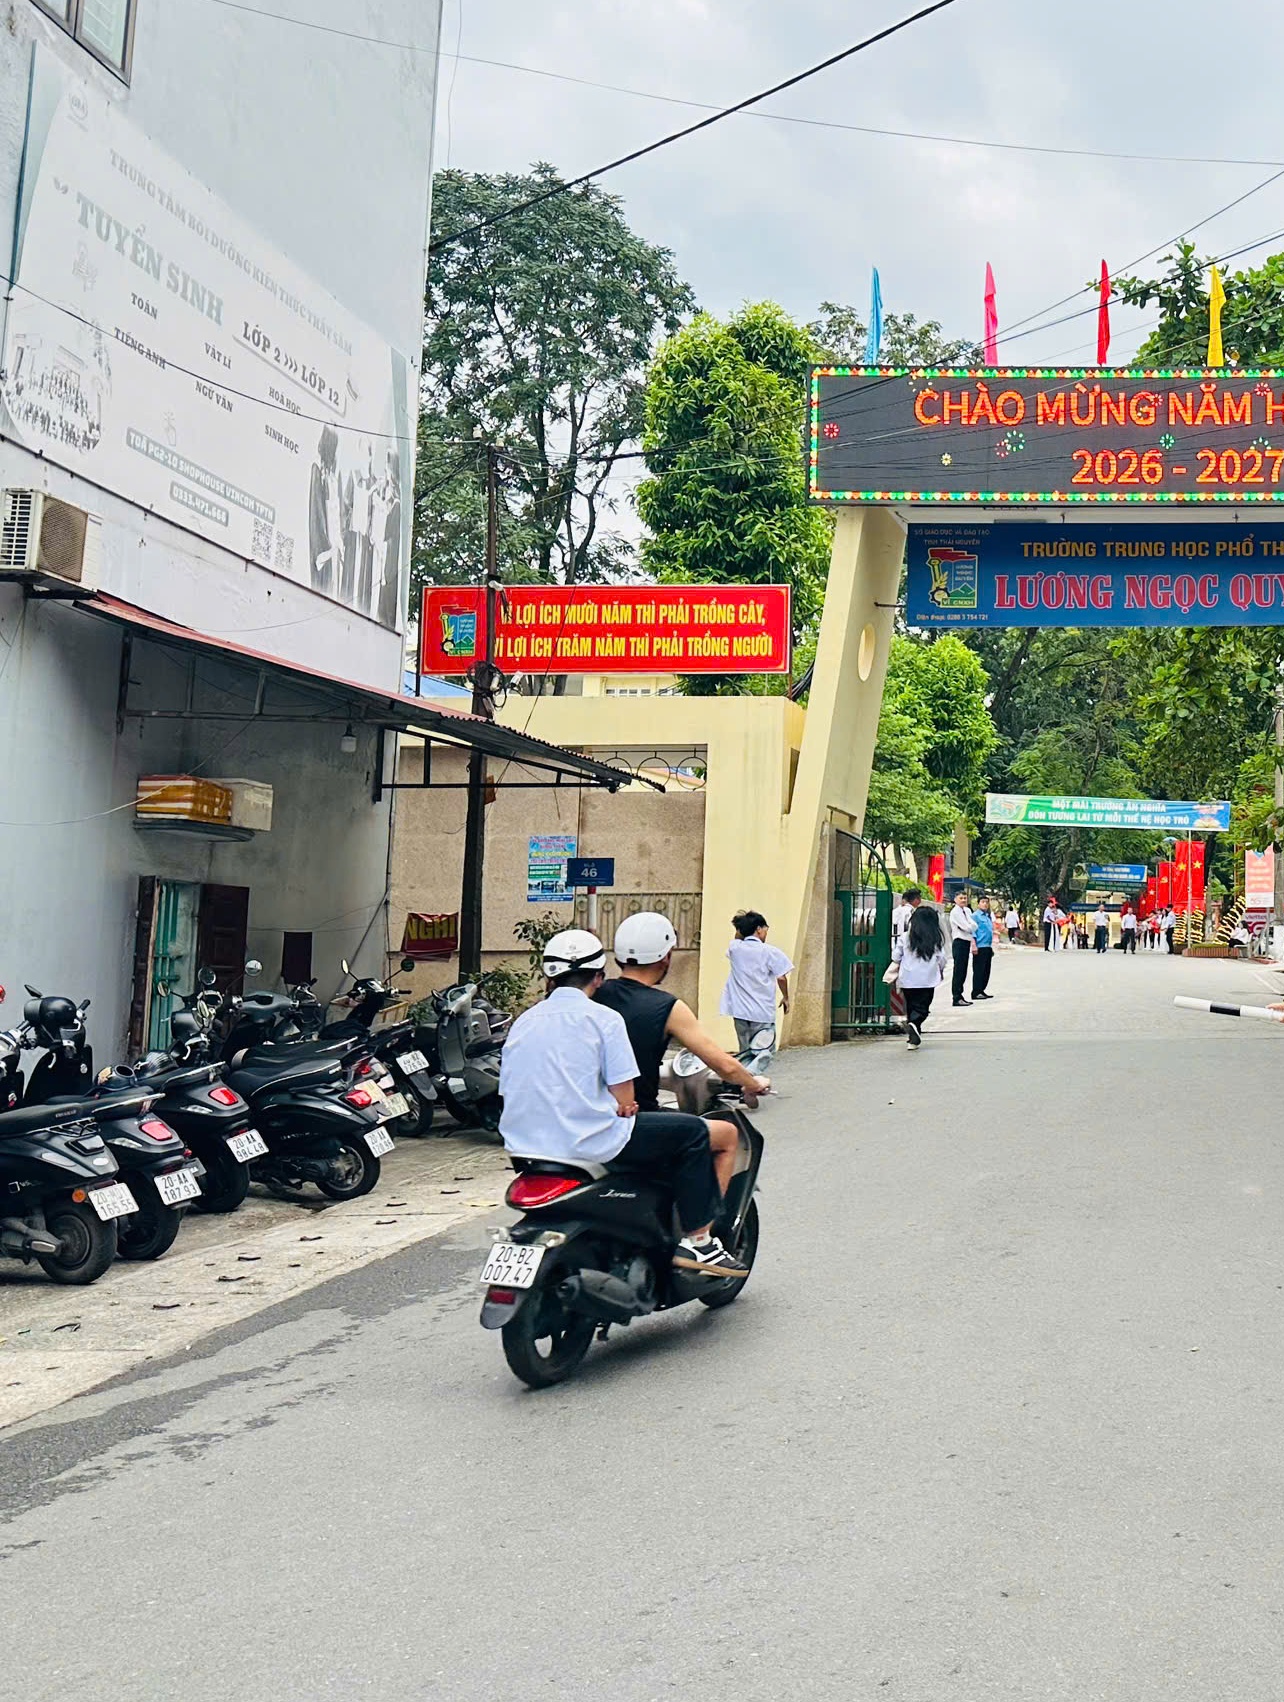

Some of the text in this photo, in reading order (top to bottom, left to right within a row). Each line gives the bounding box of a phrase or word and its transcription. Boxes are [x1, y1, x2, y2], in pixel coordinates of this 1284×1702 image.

[76, 191, 224, 327] TUYỂN SINH
[131, 292, 158, 320] TOÁN
[114, 326, 167, 370] TIẾNG ANH
[243, 321, 281, 363] LỚP 2
[301, 364, 340, 406] LỚP 12
[215, 393, 233, 413] VĂN
[914, 381, 1025, 425] CHÀO
[1036, 382, 1157, 426] MỪNG
[1168, 383, 1252, 426] NĂM
[264, 424, 299, 454] SINH HỌC
[1071, 449, 1163, 484] 2026
[179, 460, 225, 493] SHOPHOUSE
[225, 485, 255, 510] VINCOM
[1021, 538, 1097, 557] TRƯỜNG
[1103, 541, 1165, 557] TRUNG
[1171, 541, 1209, 560] HỌC
[1216, 533, 1254, 557] PHỔ
[994, 570, 1113, 610] LƯƠNG
[1124, 573, 1219, 614] NGỌC
[516, 603, 536, 628] LỢI
[539, 600, 561, 624] ÍCH
[565, 599, 598, 624] MƯỜI
[601, 600, 632, 624] NĂM
[636, 600, 655, 624] THÌ
[659, 597, 690, 624] PHẢI
[693, 597, 735, 624] TRỒNG
[739, 599, 765, 626] CÂY,
[507, 636, 527, 661] LỢI
[530, 633, 552, 657] ÍCH
[556, 633, 592, 657] TRĂM
[595, 633, 626, 657] NĂM
[629, 632, 650, 657] THÌ
[652, 630, 683, 657] PHẢI
[687, 630, 729, 657] TRỒNG
[733, 631, 772, 657] NGƯỜI
[581, 868, 598, 878] 46
[484, 1264, 532, 1284] 007.47
